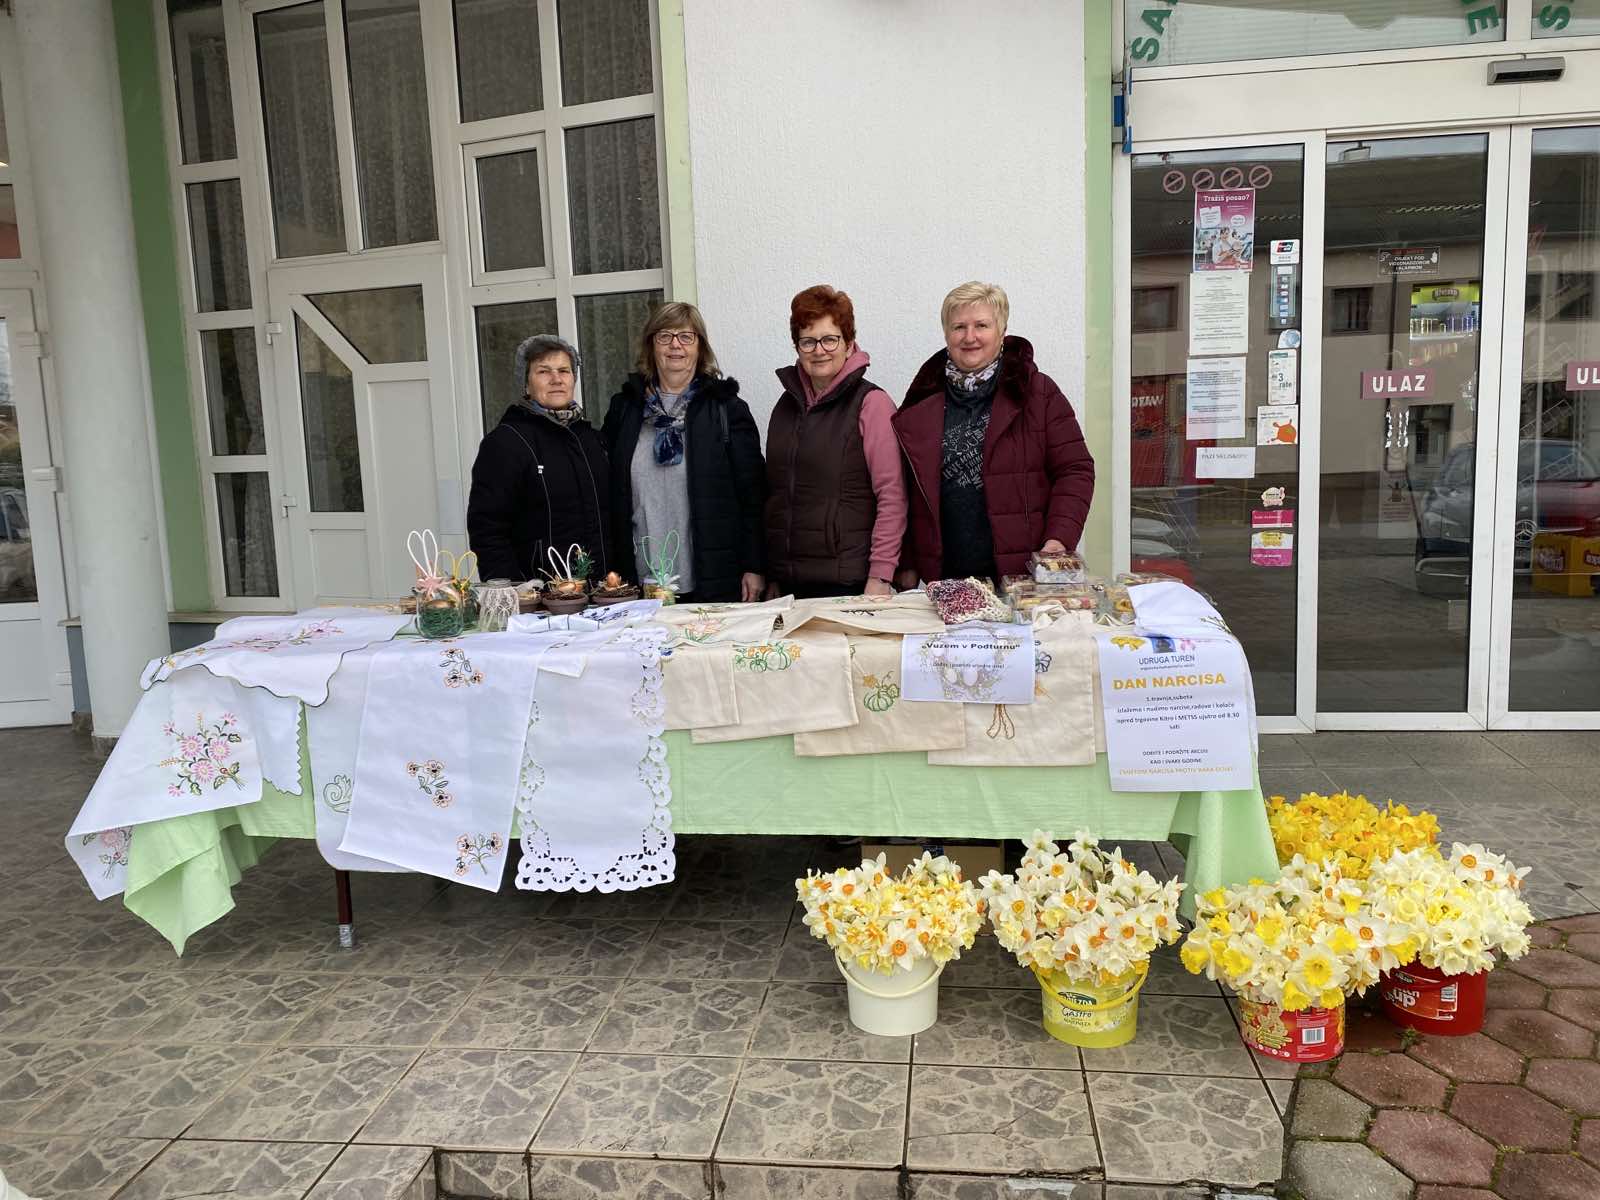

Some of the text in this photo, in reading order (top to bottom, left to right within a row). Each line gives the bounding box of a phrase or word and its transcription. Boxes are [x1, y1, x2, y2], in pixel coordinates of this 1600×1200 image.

[1131, 0, 1178, 61] SA
[1225, 194, 1250, 203] posao?
[1278, 373, 1284, 382] 3
[1372, 375, 1426, 393] ULAZ
[1576, 367, 1600, 385] UL
[1138, 654, 1195, 665] UDRUGA TUREN
[1113, 673, 1226, 690] DAN NARCISA
